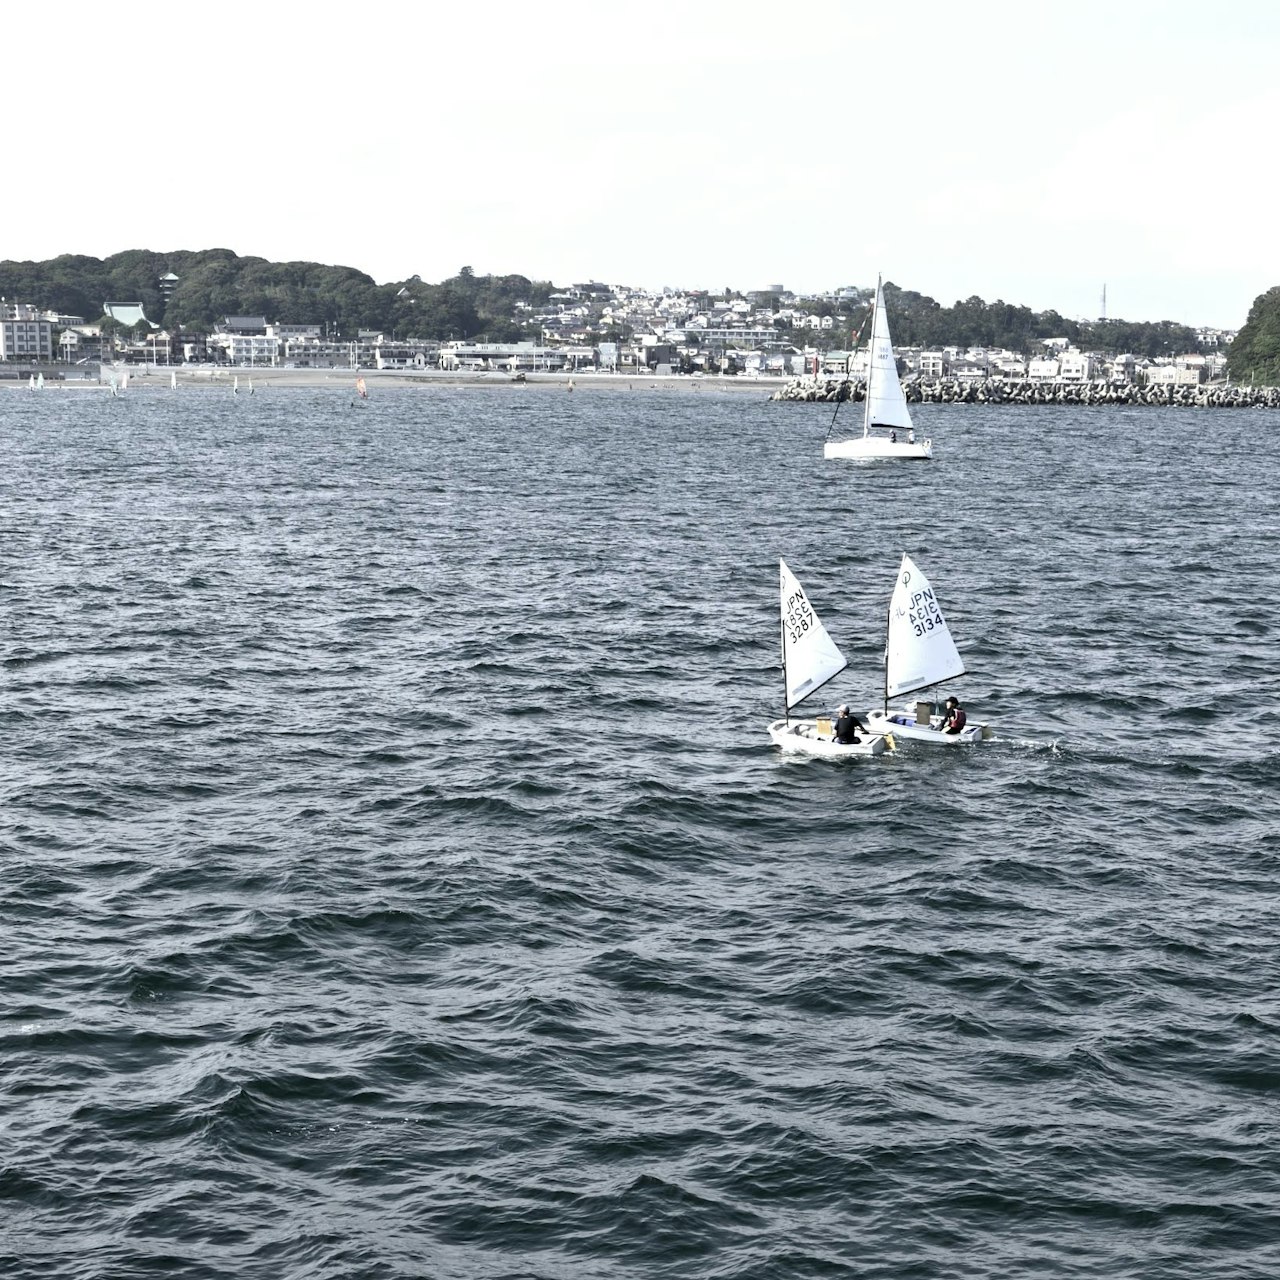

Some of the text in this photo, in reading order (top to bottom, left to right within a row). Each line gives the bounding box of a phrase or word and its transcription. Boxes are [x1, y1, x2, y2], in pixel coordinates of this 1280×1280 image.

[787, 589, 804, 613] JPN
[909, 588, 933, 610] JPN
[790, 613, 814, 644] 3287
[913, 613, 943, 637] 3134
